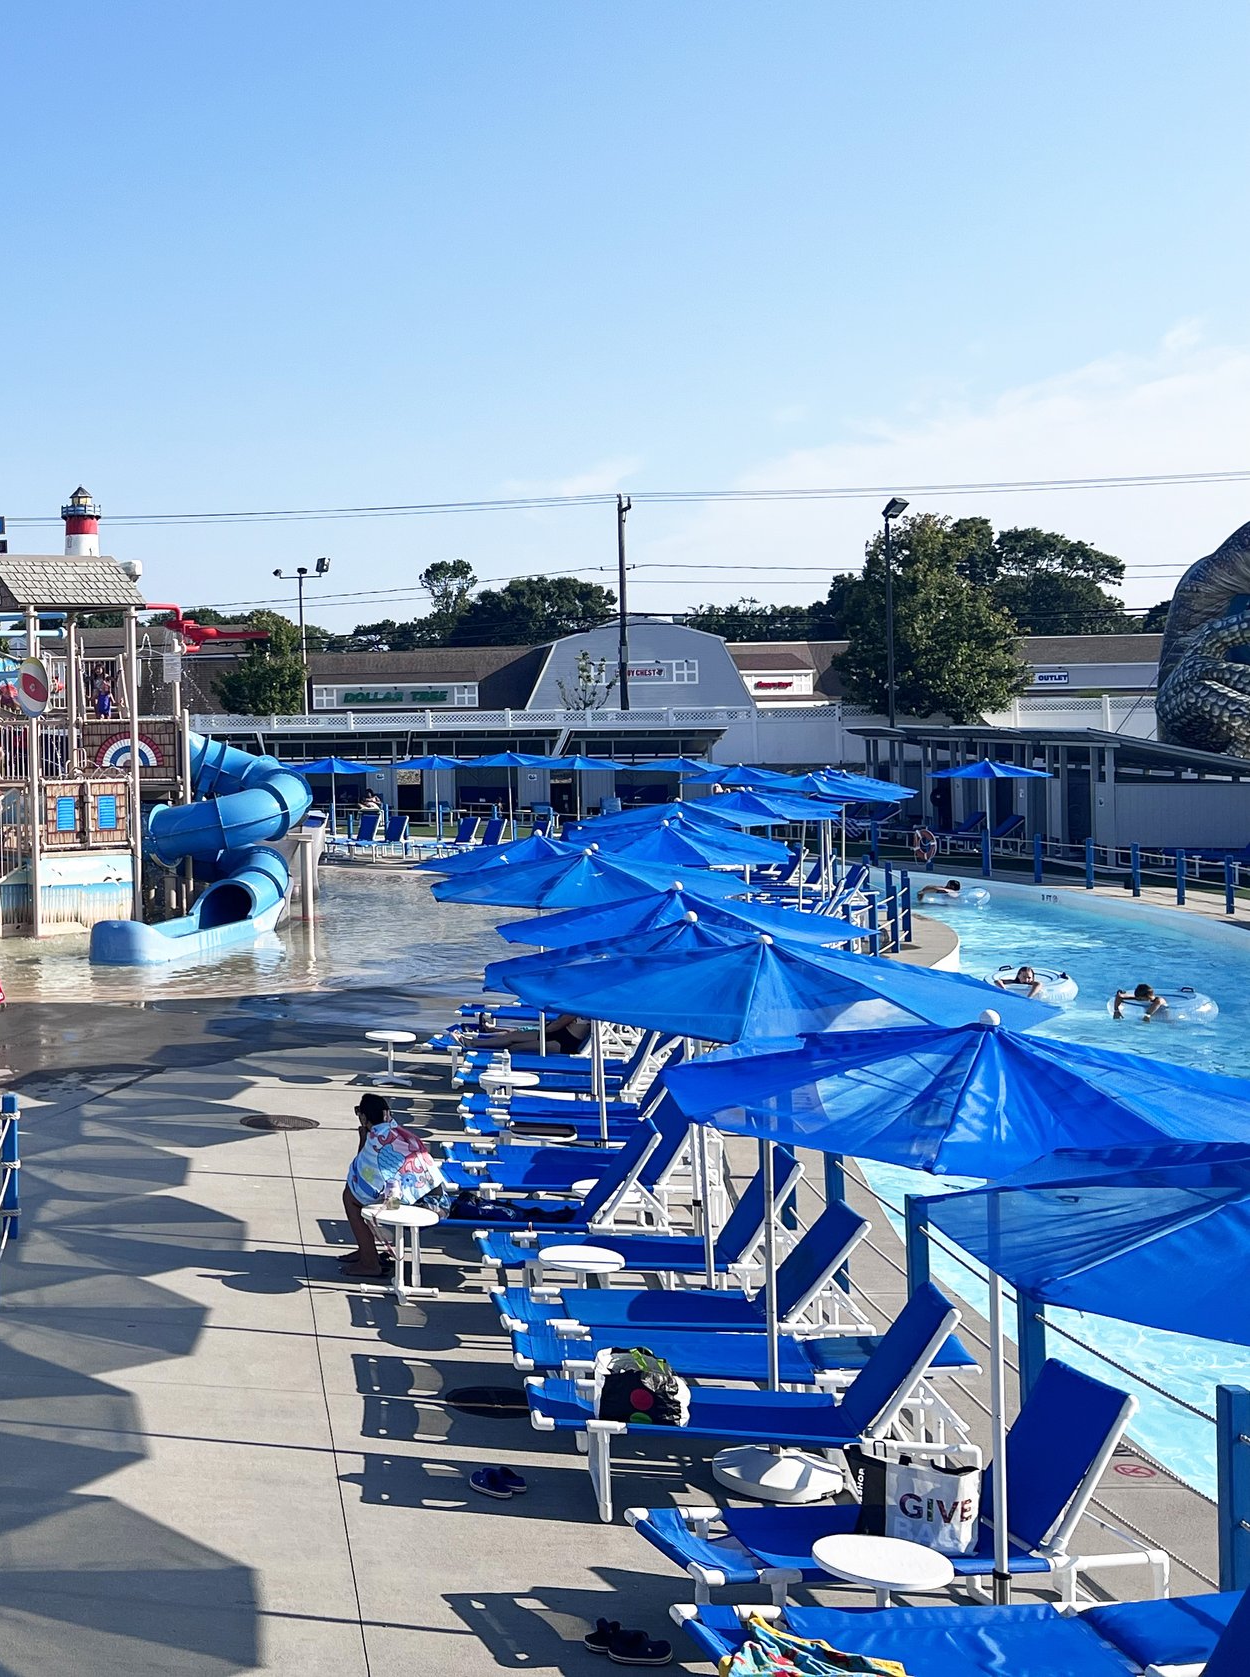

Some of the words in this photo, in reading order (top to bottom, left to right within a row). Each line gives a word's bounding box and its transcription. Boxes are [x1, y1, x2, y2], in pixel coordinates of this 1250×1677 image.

[1038, 674, 1068, 682] OUTLET
[343, 691, 404, 703] DOLLAR
[410, 690, 448, 702] TREE
[899, 1493, 972, 1524] GIVE
